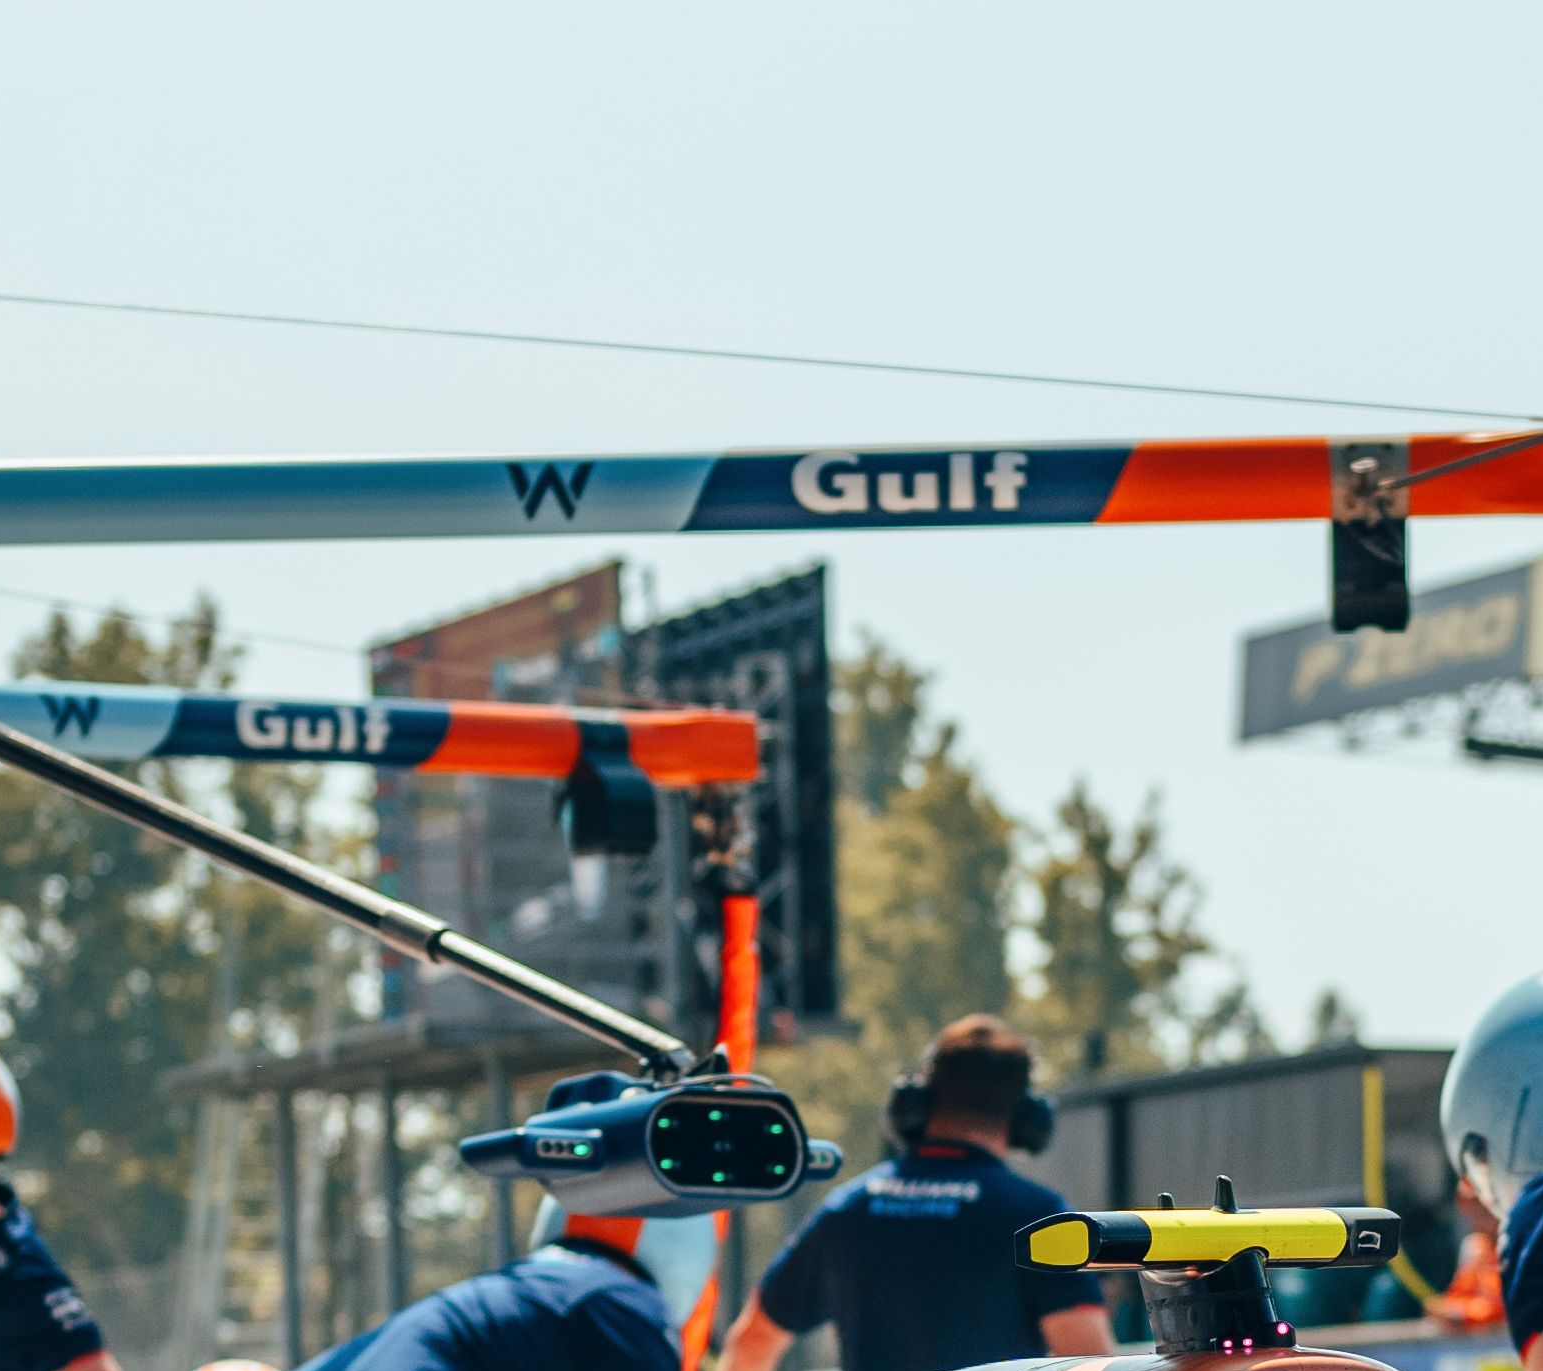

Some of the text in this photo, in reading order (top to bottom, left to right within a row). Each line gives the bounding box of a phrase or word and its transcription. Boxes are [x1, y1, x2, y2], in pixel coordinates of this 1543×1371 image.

[506, 461, 595, 520] W
[791, 451, 1028, 514] Gulf
[40, 694, 102, 738] W
[236, 700, 390, 752] Gulf
